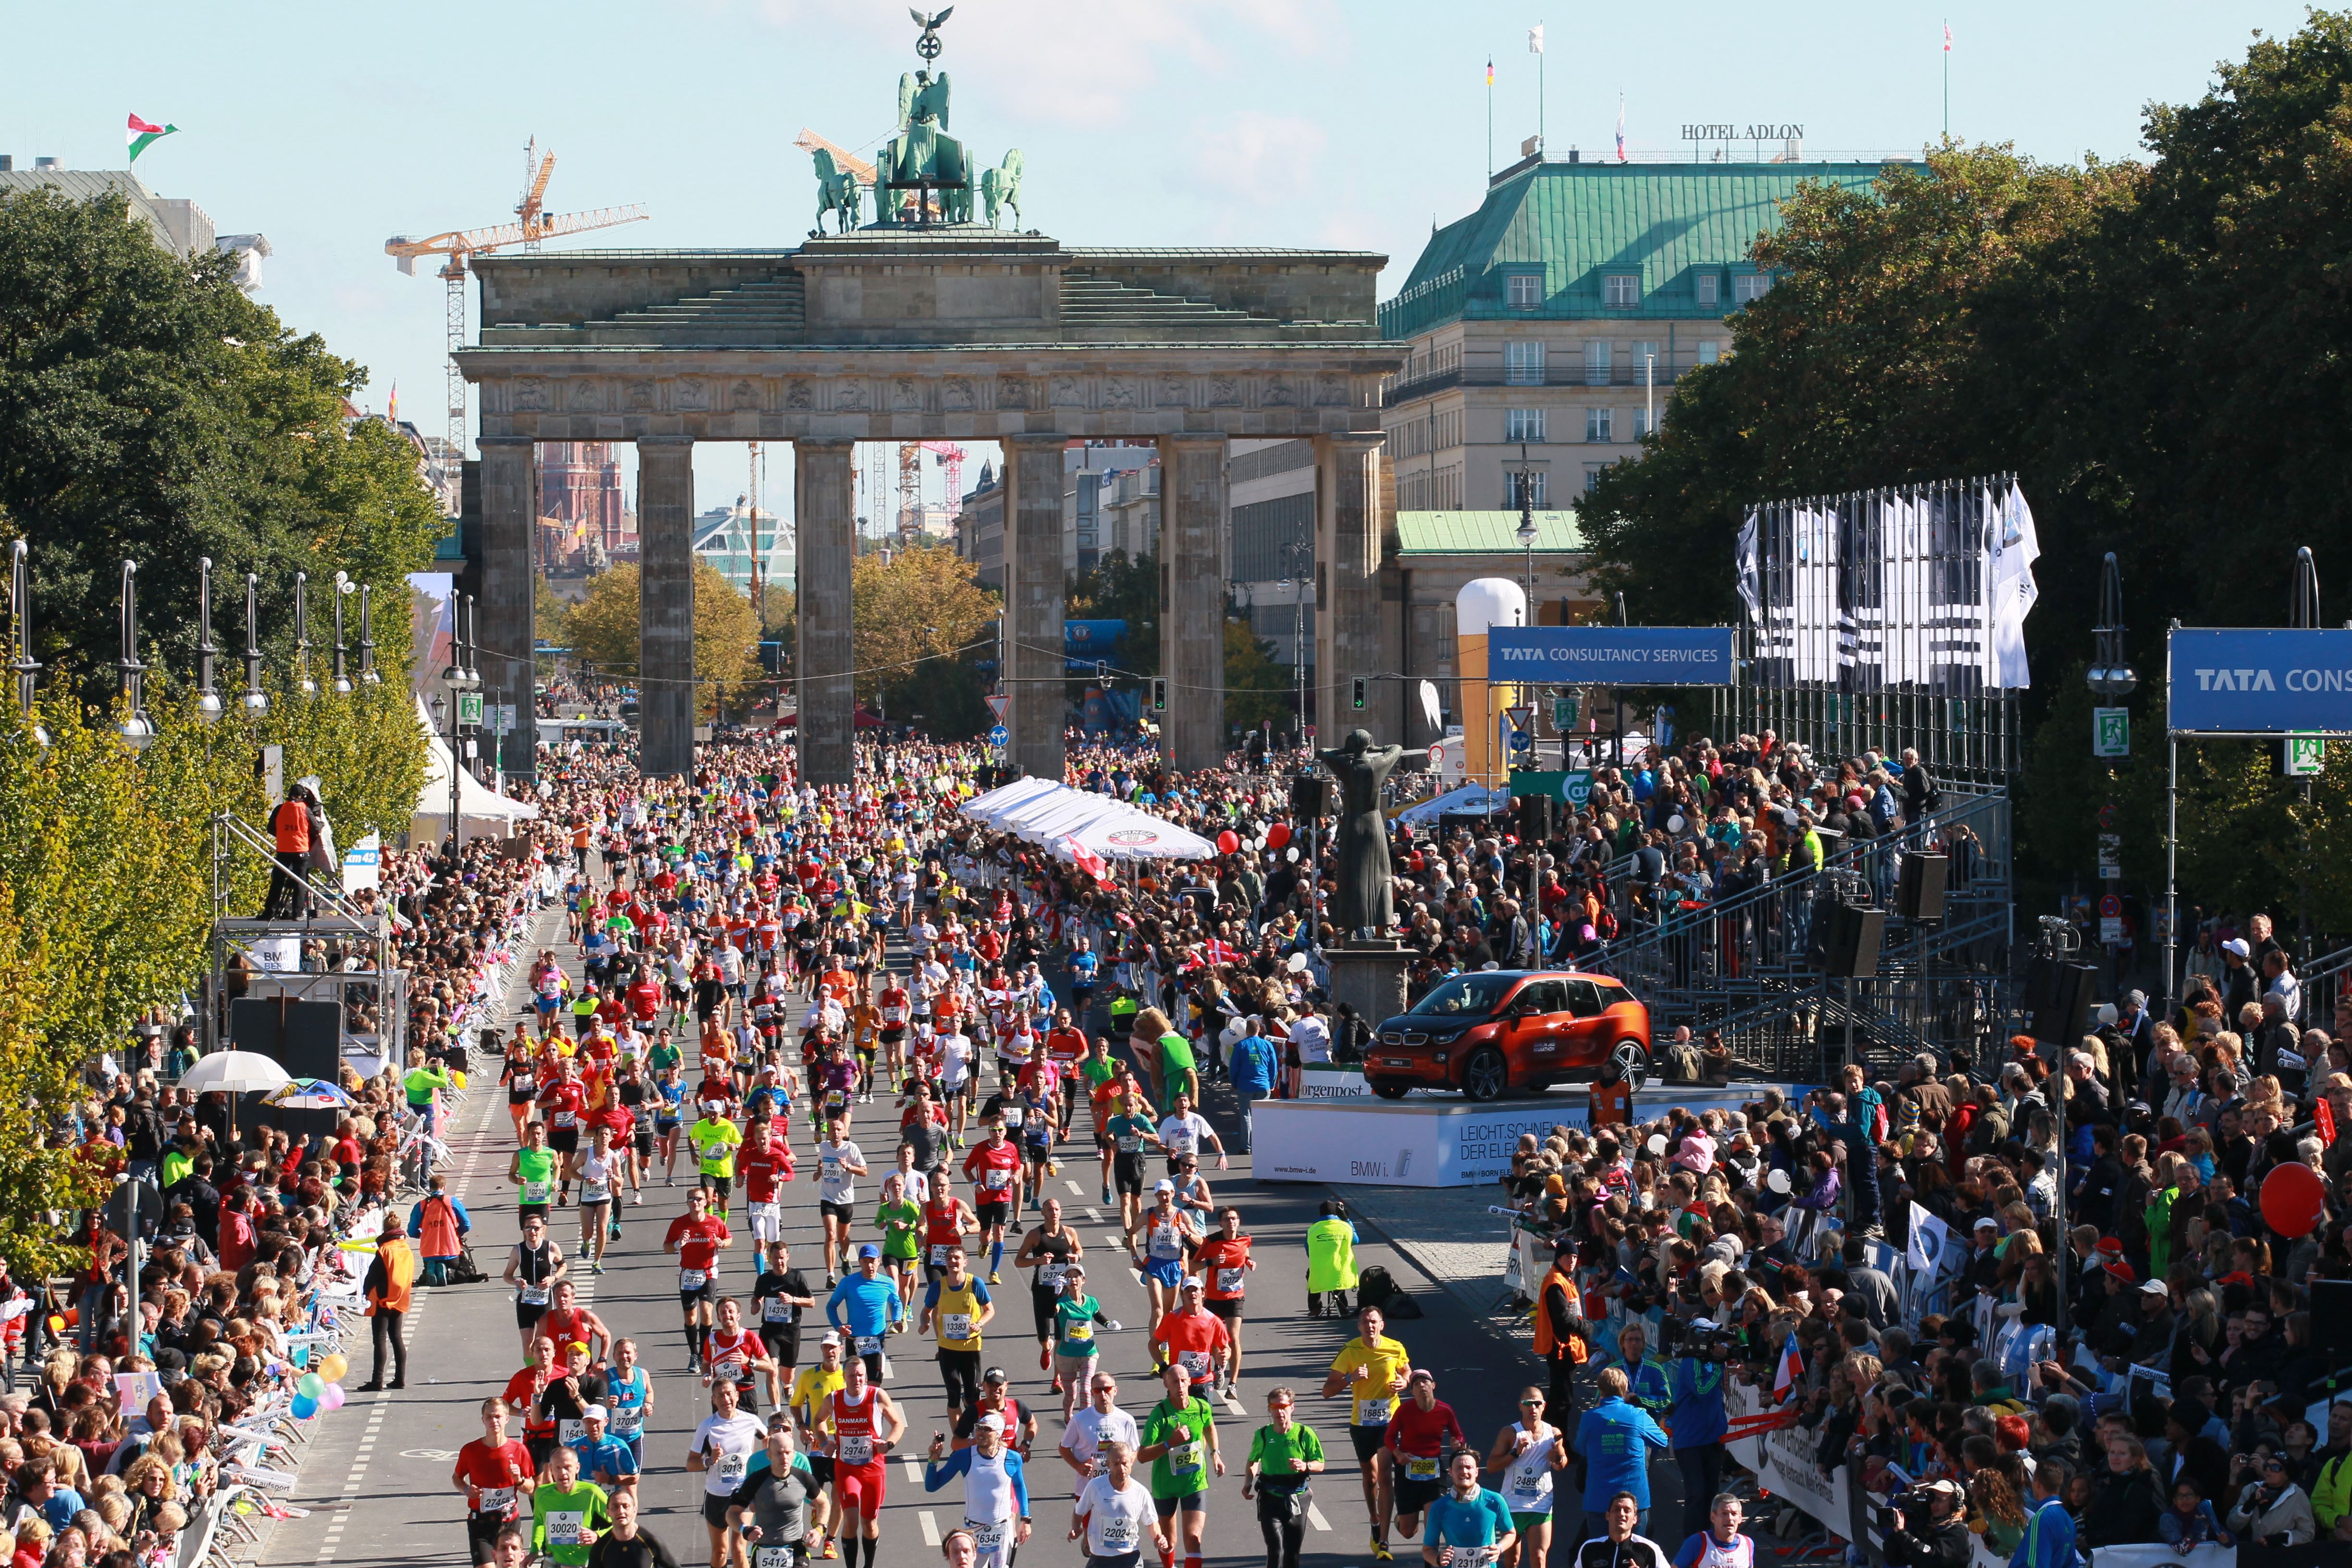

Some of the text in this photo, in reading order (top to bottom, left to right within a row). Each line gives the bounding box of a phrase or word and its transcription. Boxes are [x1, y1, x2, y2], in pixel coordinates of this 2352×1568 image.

[1681, 124, 1804, 139] HOTEL ADLON
[1501, 648, 1717, 662] TATA CONSULTANCY SERVICES
[2195, 669, 2276, 691] TATA
[346, 852, 375, 863] km 42
[1299, 1084, 1362, 1097] orgenpost
[1461, 1144, 1486, 1161] DER
[1352, 1161, 1381, 1177] BMW
[1481, 1170, 1499, 1178] BORN
[1501, 1209, 1516, 1218] BMW
[1223, 1276, 1239, 1284] 9072
[526, 1289, 544, 1298] 20898
[769, 1306, 787, 1314] 14376
[947, 1322, 966, 1331] 13383
[559, 1332, 572, 1342] PK
[1182, 1360, 1203, 1371] 6546
[2134, 1367, 2169, 1383] Laufsport
[1364, 1408, 1385, 1417] 16855
[616, 1416, 638, 1426] 37079
[565, 1430, 587, 1439] 1643
[844, 1446, 868, 1456] 29747
[1176, 1451, 1198, 1465] 697
[1411, 1460, 1435, 1470] F6899
[255, 1478, 290, 1494] Laufsport
[485, 1496, 510, 1508] 27458
[551, 1523, 577, 1533] 30020
[1104, 1527, 1130, 1537] 22024
[976, 1534, 1002, 1544] 16345
[762, 1557, 787, 1568] 5412
[1458, 1557, 1485, 1568] 23119
